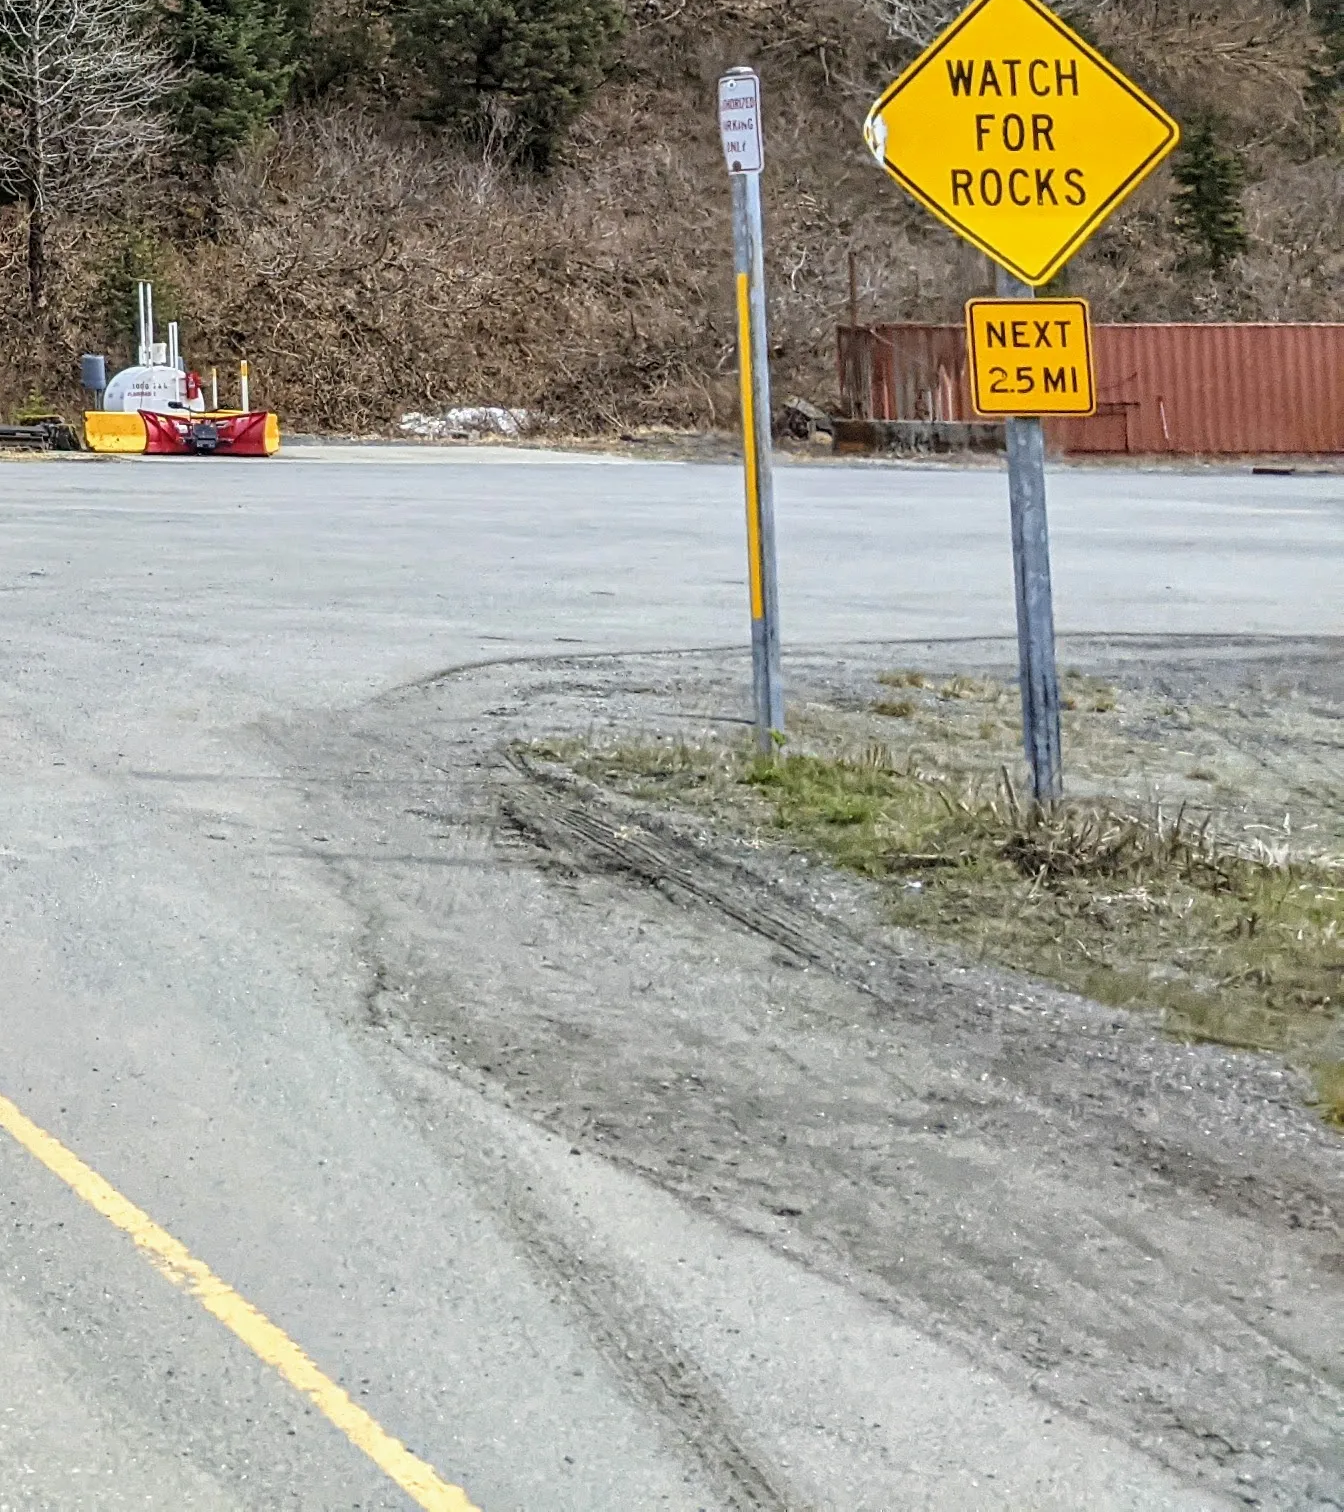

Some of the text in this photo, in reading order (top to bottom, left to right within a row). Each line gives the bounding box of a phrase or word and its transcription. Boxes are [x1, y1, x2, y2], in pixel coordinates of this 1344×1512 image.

[945, 59, 1080, 97] WATCH
[975, 113, 1056, 152] FOR
[950, 167, 1087, 206] ROCKS
[985, 320, 1072, 348] NEXT
[988, 366, 1078, 394] 2.5 MI
